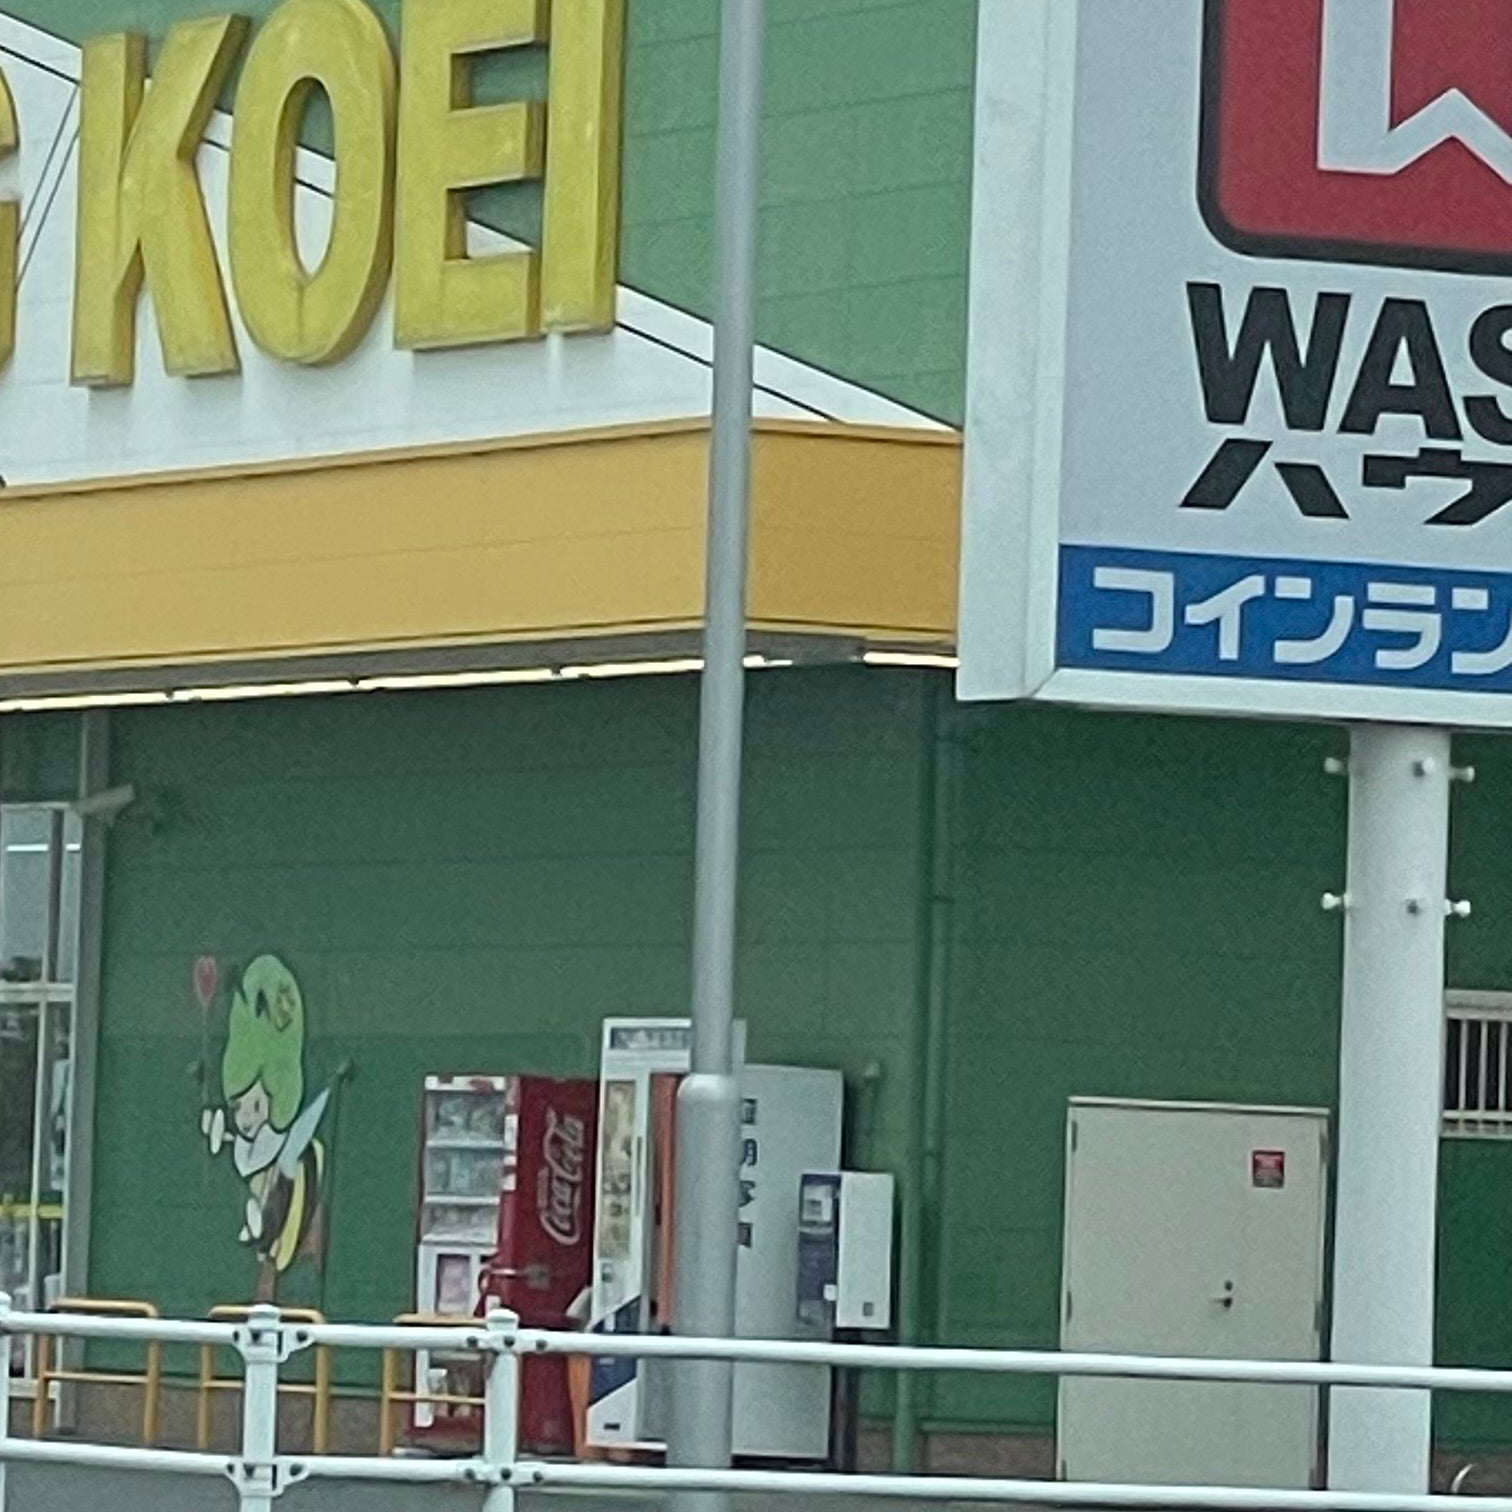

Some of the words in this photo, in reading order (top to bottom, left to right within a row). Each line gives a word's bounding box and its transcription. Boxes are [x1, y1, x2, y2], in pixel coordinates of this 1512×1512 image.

[1092, 566, 1512, 674] コインラン
